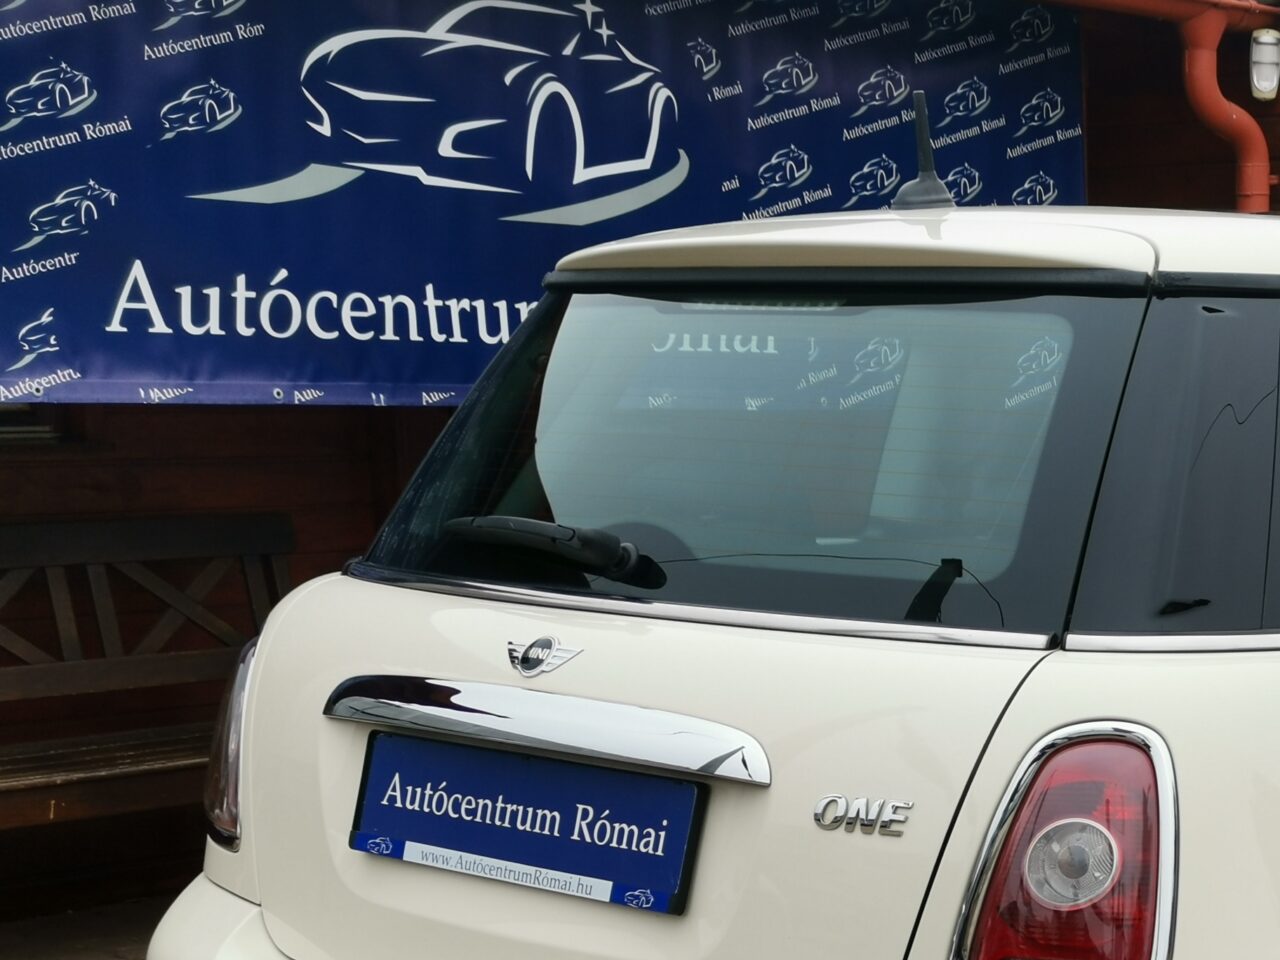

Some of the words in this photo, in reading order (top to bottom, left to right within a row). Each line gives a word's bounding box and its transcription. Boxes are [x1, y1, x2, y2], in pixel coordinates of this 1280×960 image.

[89, 0, 137, 21] Római
[728, 14, 788, 38] Autócentrum
[789, 2, 819, 21] Római
[144, 30, 234, 60] Autócentrum
[824, 28, 880, 52] Autócentrum
[881, 17, 910, 35] Római
[914, 40, 967, 64] Autócentrum
[968, 30, 996, 48] Római
[998, 53, 1046, 75] Autócentrum
[1046, 44, 1071, 59] Római
[712, 81, 743, 101] Római
[747, 105, 809, 131] Autócentrum
[810, 92, 841, 112] Római
[981, 114, 1006, 133] Római
[0, 131, 81, 160] tócentrum
[83, 116, 132, 140] Római
[842, 115, 900, 142] Autócentrum
[1006, 136, 1055, 159] Autócentrum
[1056, 124, 1082, 142] Római
[802, 184, 832, 204] Római
[1, 252, 80, 282] Autócentr
[839, 381, 894, 410] Autócentrum
[380, 771, 561, 837] Autócentrum
[570, 803, 669, 856] Római
[812, 793, 915, 838] ONE
[420, 848, 593, 896] www.AutócentrumRómai.hu
